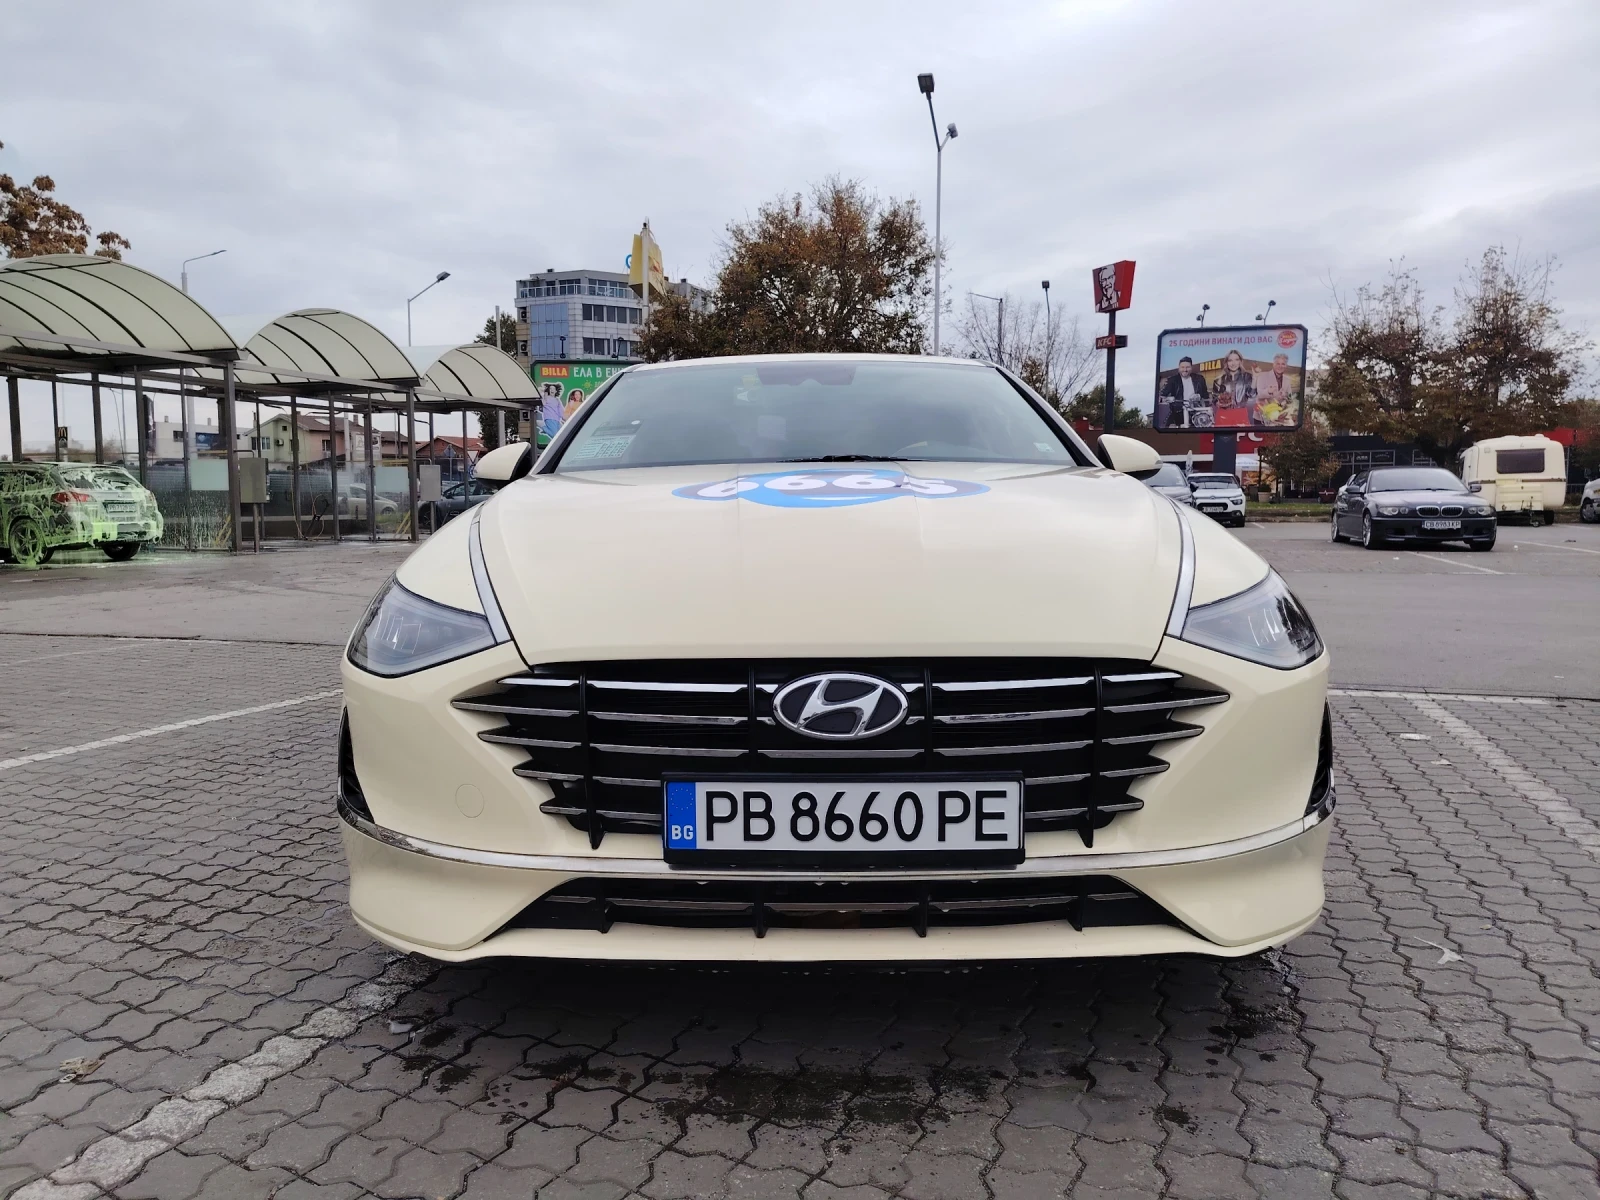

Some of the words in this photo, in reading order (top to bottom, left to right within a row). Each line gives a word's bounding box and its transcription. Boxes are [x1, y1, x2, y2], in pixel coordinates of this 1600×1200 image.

[1097, 337, 1113, 347] KFC
[1179, 338, 1210, 347] ГОДИНИ
[1211, 337, 1242, 345] ВИНАГИ
[1244, 336, 1256, 344] ДО
[1257, 335, 1273, 343] ВАС
[1200, 359, 1222, 371] BILLA
[541, 367, 568, 376] BILLA
[573, 367, 593, 378] ЕЛА
[596, 367, 602, 378] В
[705, 790, 776, 842] PB
[790, 790, 924, 842] 8660
[938, 790, 1008, 842] PE
[671, 824, 694, 841] BG
